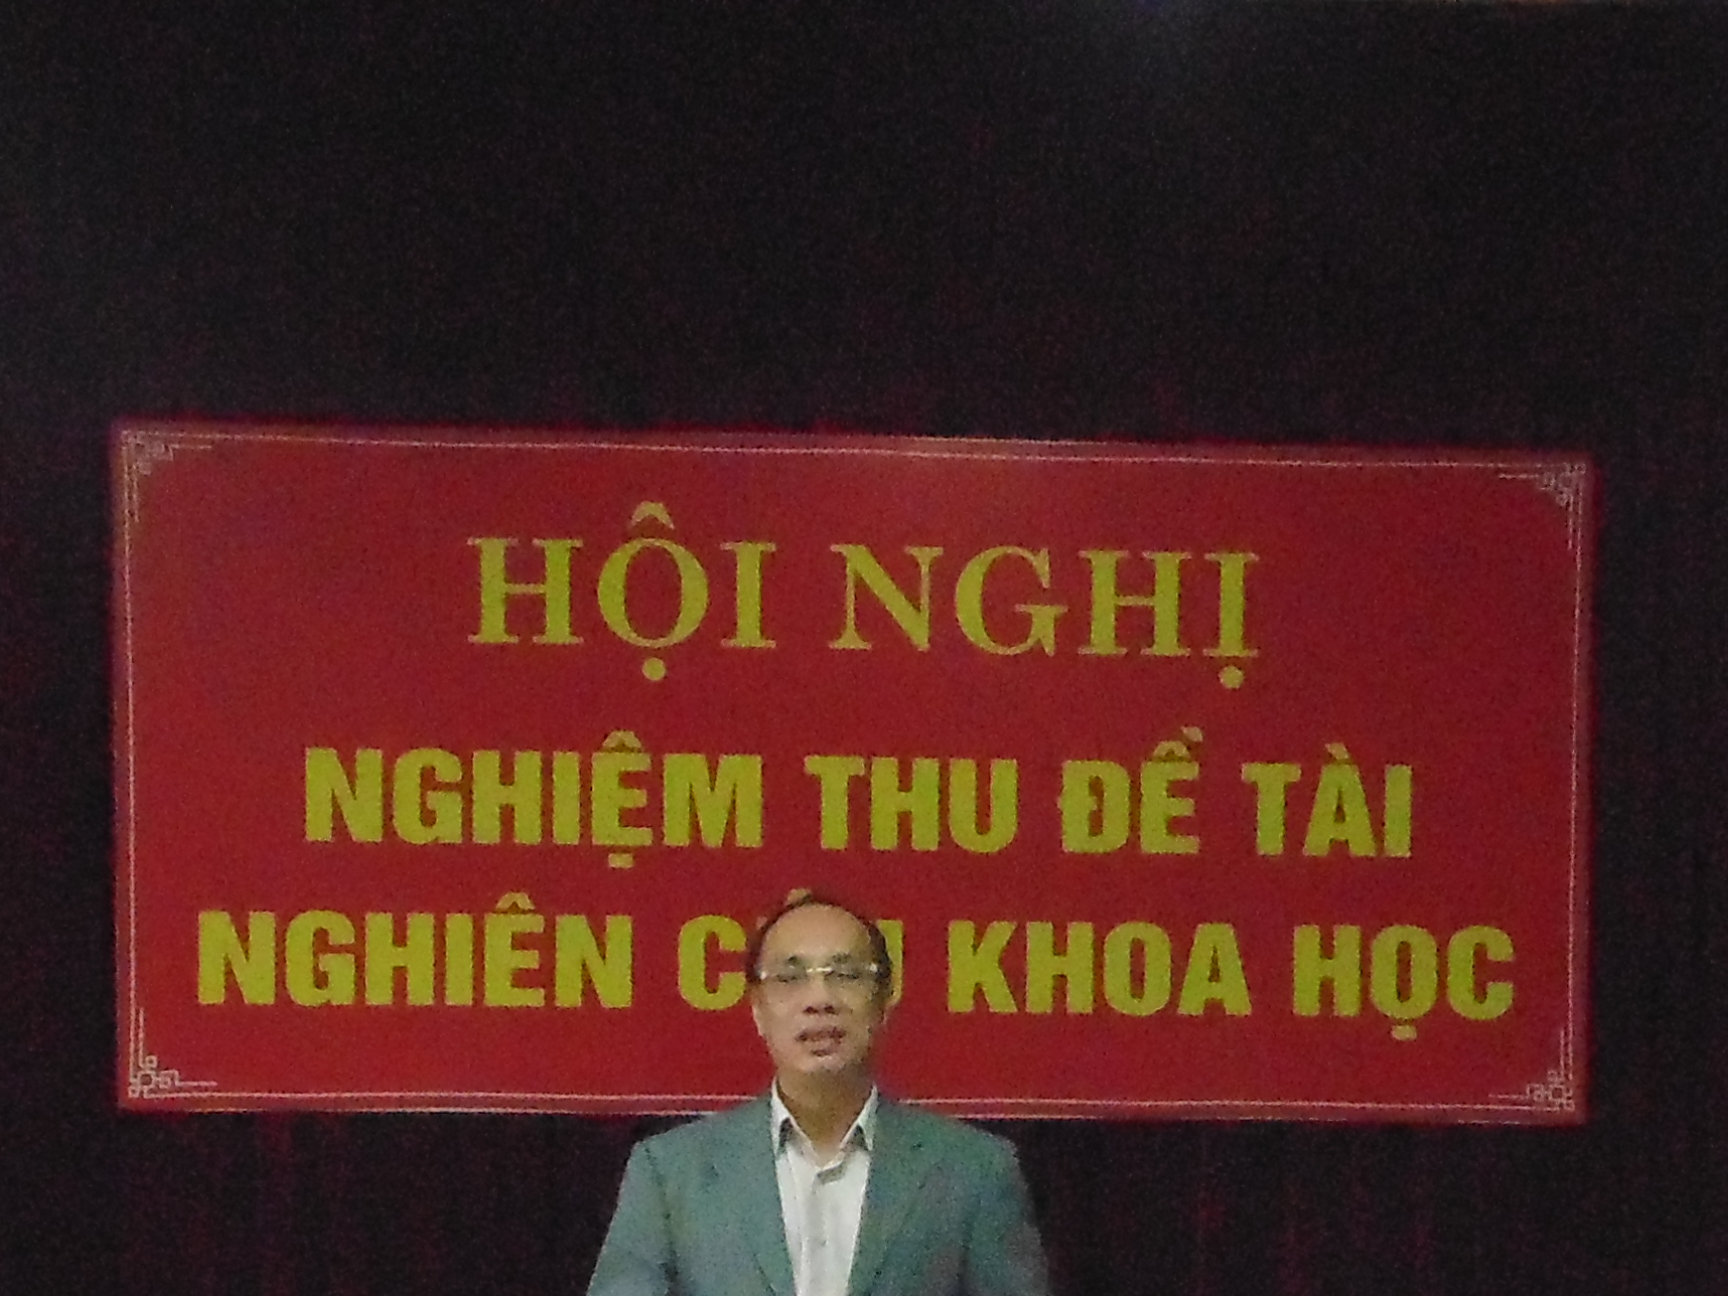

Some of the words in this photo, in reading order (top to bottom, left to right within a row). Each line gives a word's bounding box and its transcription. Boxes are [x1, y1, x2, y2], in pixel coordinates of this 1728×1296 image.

[469, 500, 778, 682] HỘI
[829, 540, 1259, 690] NGHỊ
[303, 729, 764, 869] NGHIỆM
[804, 754, 1020, 854] THU
[1056, 726, 1204, 856] ĐỀ
[1242, 743, 1414, 858] TÀI
[195, 891, 635, 1010] NGHIÊN
[946, 919, 1254, 1018] KHOA
[1292, 924, 1516, 1040] HỌC
